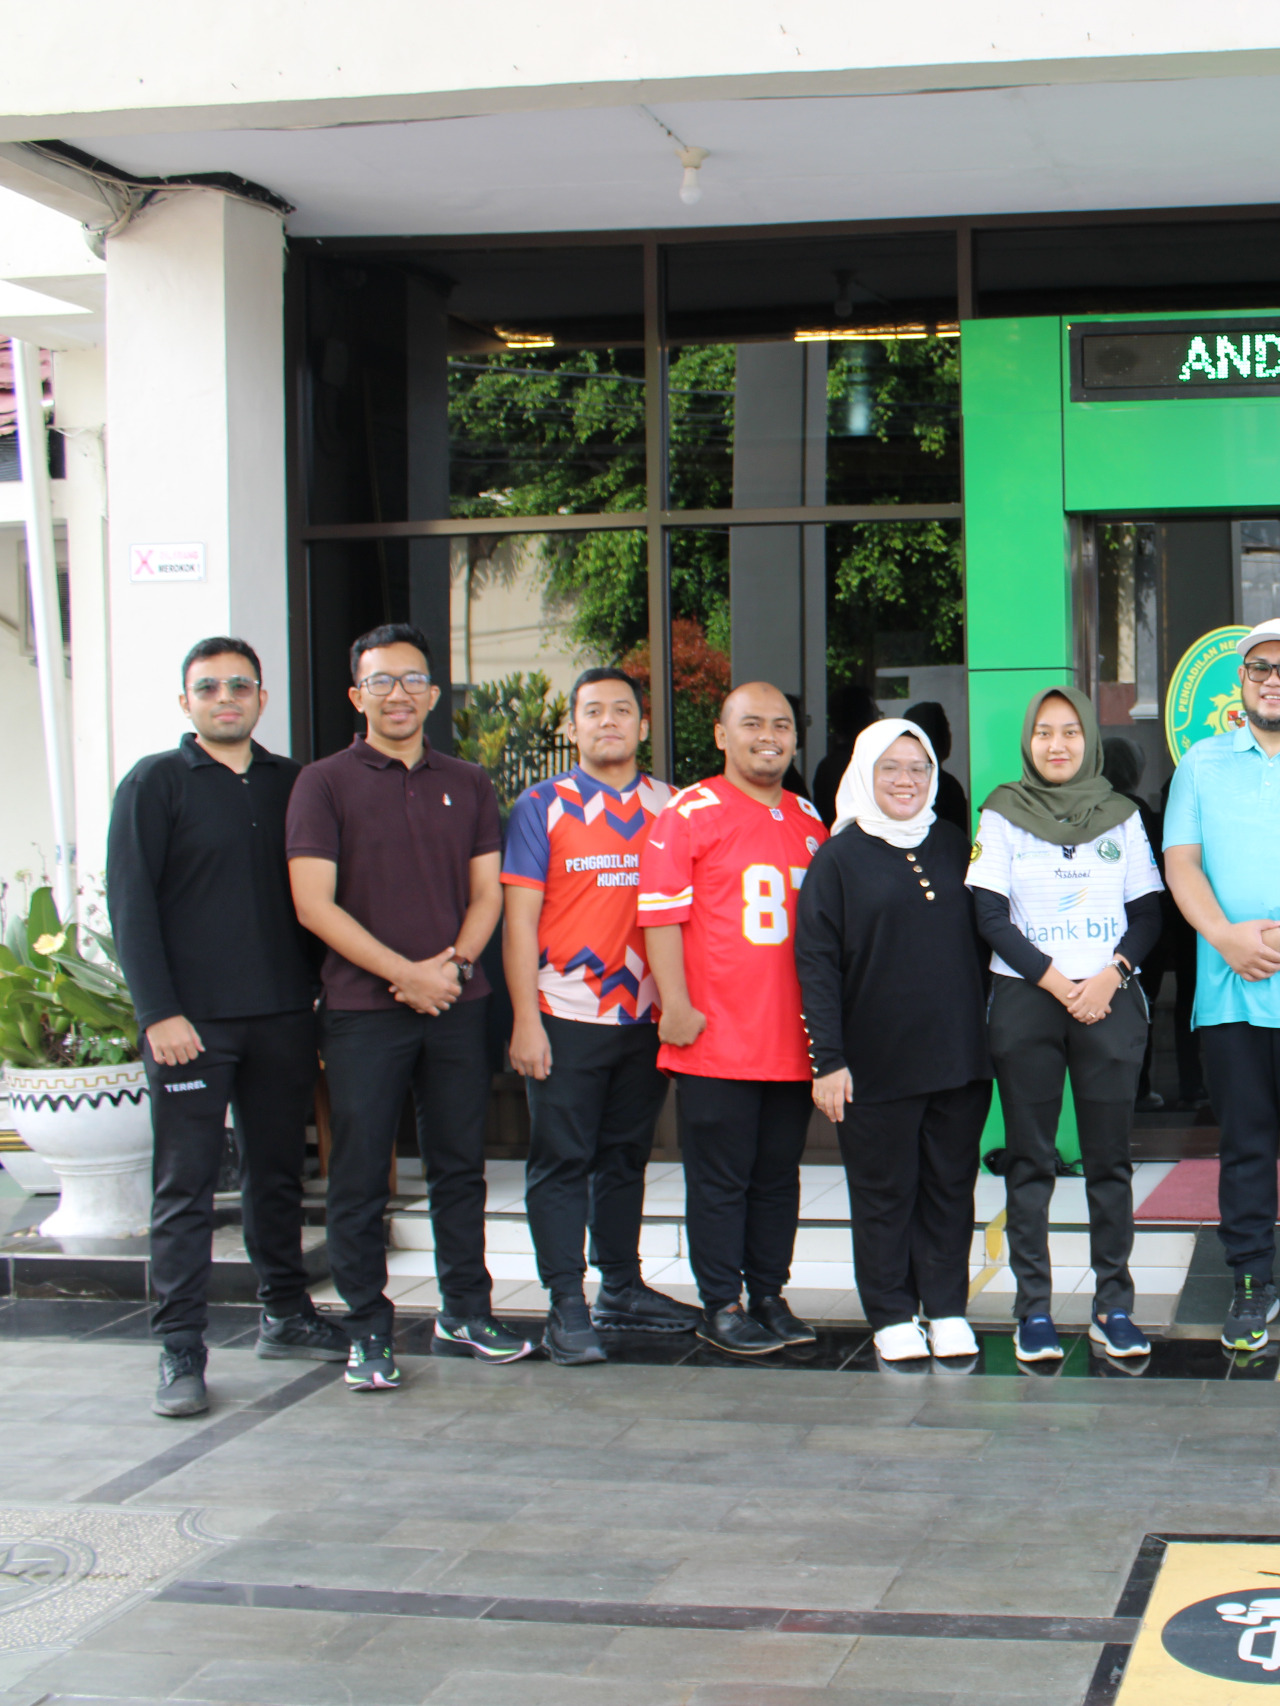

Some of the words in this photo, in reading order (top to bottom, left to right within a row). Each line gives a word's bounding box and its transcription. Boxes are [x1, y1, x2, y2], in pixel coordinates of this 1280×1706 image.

[1178, 646, 1218, 713] PENGADILAN
[565, 853, 639, 873] PENGADILAN
[597, 872, 640, 887] KUNING
[1025, 919, 1079, 942] bank
[164, 1079, 207, 1093] TERREL
